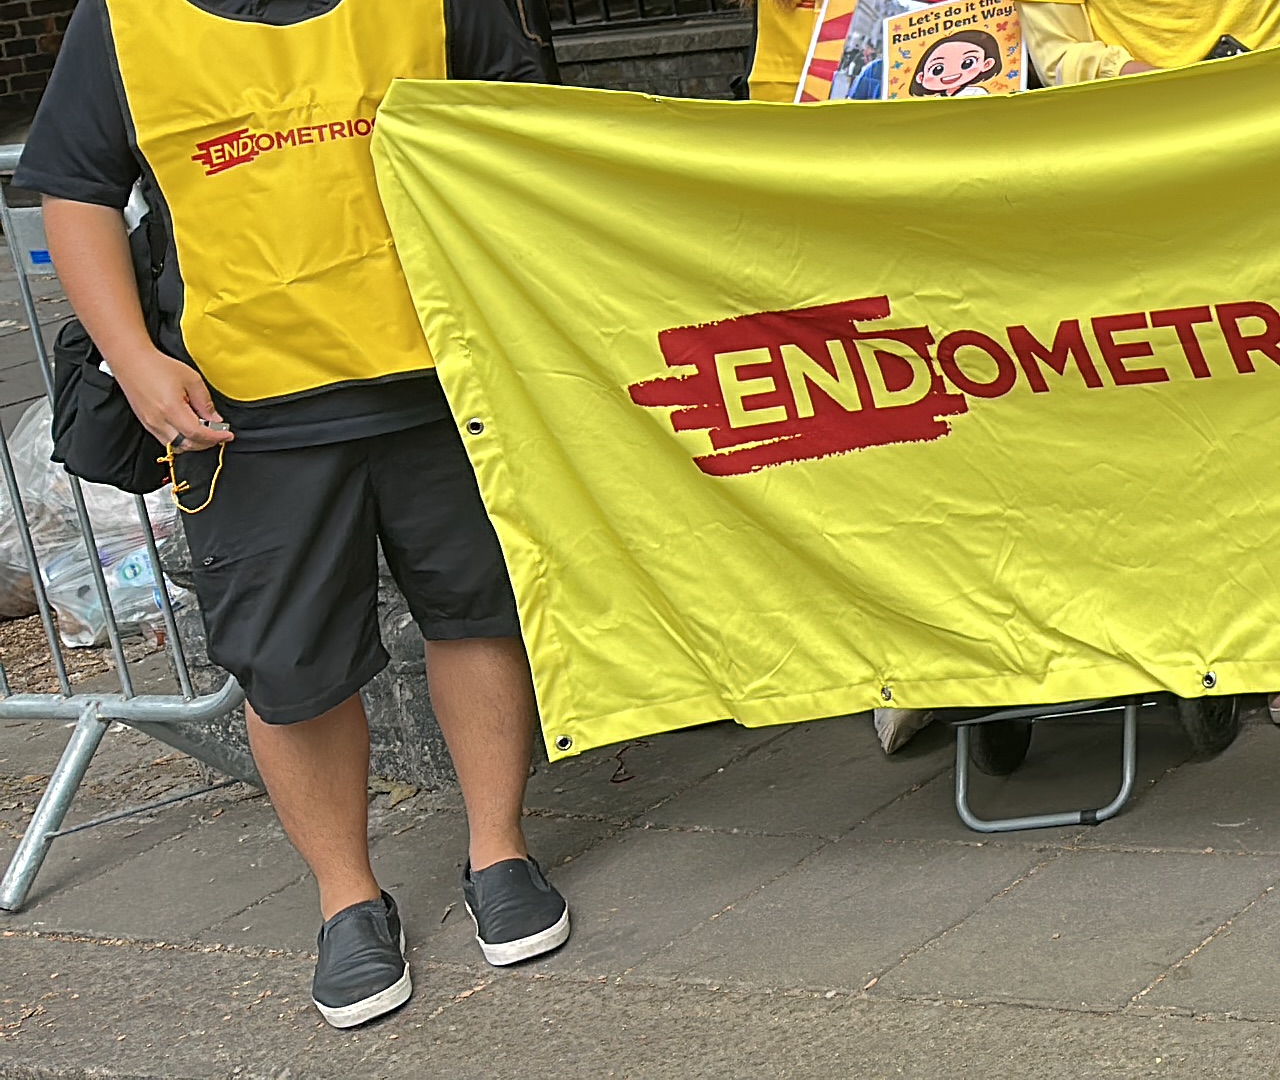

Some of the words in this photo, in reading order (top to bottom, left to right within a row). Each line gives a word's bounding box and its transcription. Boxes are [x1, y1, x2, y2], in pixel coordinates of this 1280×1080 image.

[908, 10, 941, 28] Let's
[944, 6, 962, 18] do
[965, 2, 976, 13] it
[892, 23, 940, 45] Rachel
[943, 15, 978, 32] Dent
